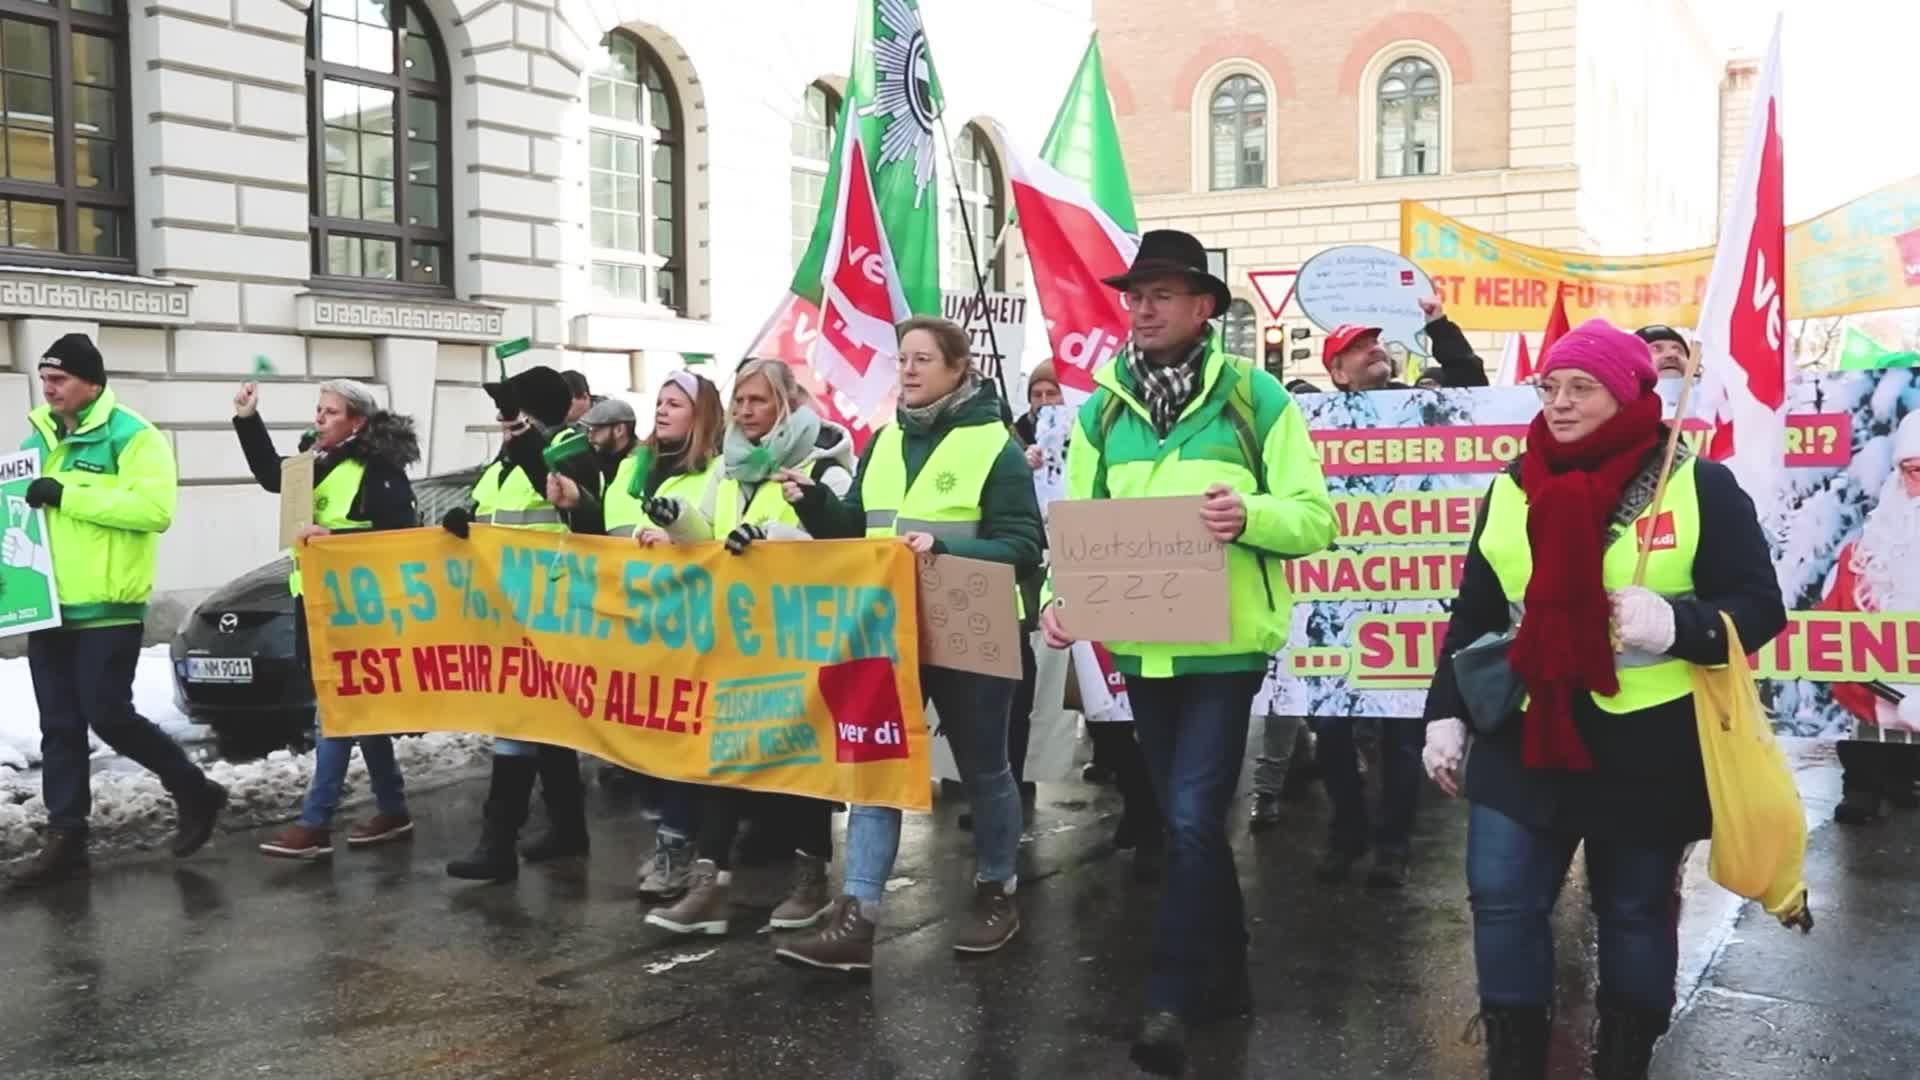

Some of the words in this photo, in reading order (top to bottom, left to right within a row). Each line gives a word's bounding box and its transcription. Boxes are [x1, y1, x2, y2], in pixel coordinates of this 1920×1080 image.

[1474, 276, 1549, 308] MEHR
[323, 560, 438, 636] 10,5
[500, 545, 612, 641] MIN.
[726, 581, 762, 656] €
[769, 584, 899, 664] MEHR
[332, 647, 403, 697] IST
[412, 644, 493, 693] MEHR
[498, 636, 559, 701] FÜR
[603, 668, 708, 736] ALLE!
